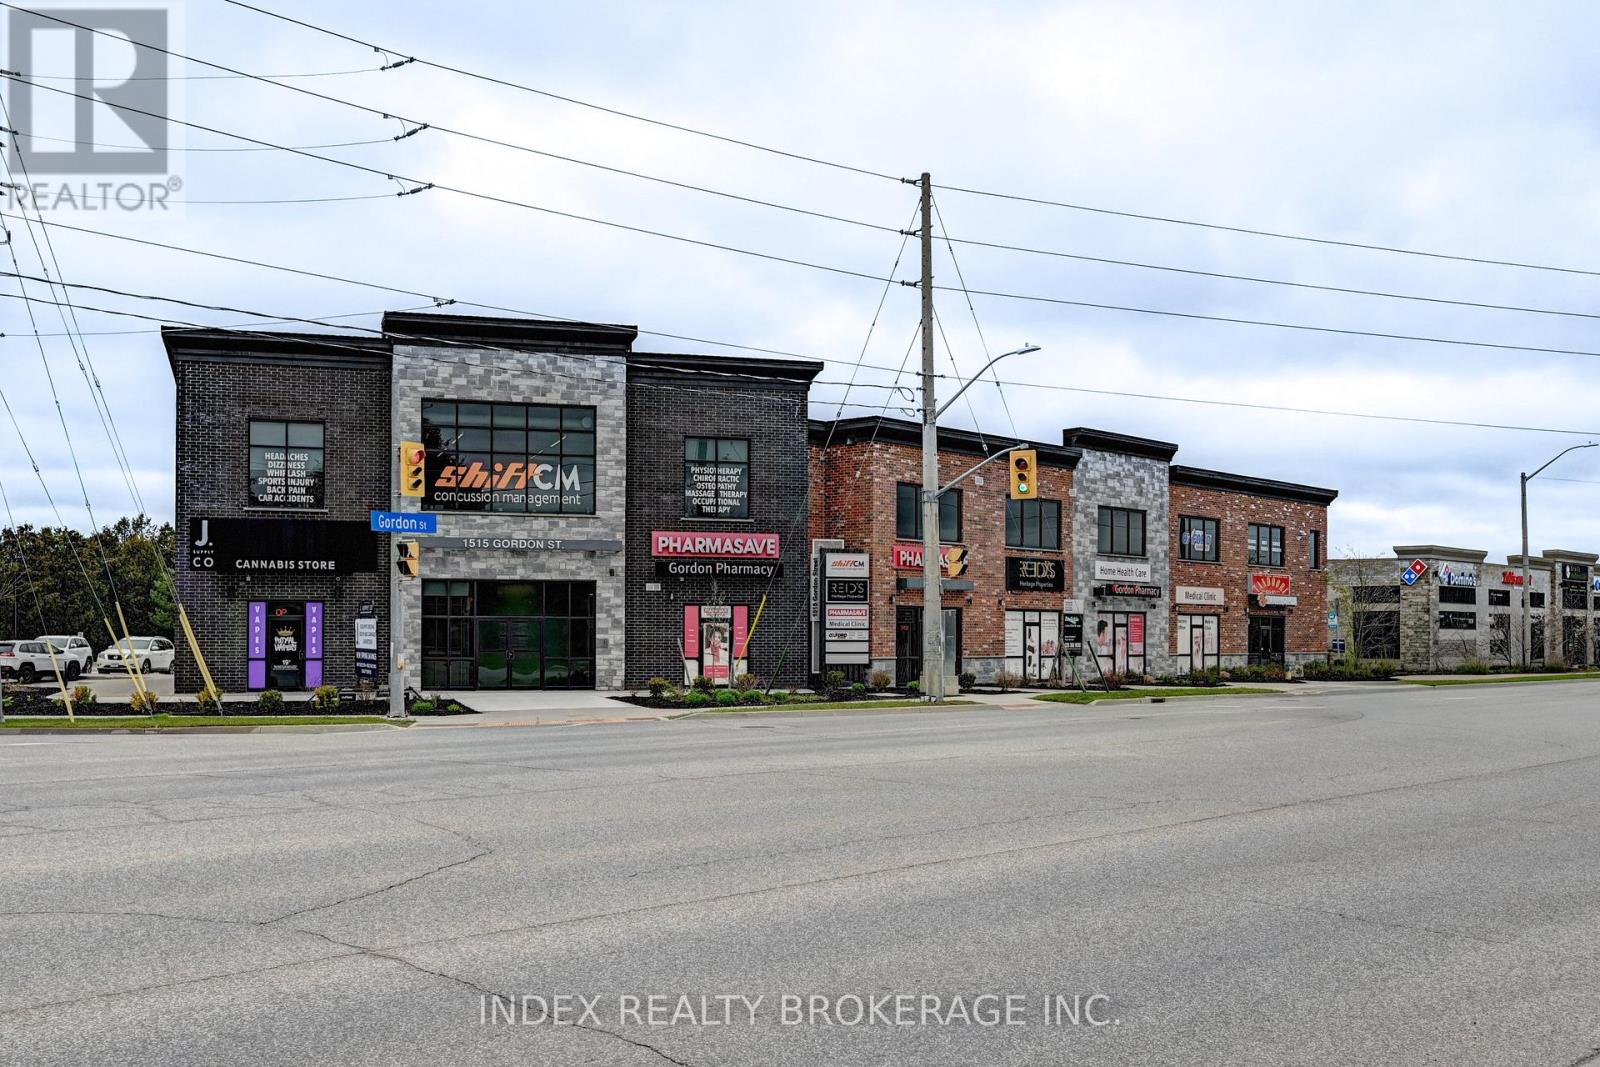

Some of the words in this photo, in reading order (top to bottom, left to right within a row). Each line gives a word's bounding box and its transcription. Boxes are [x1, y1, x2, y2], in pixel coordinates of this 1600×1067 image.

[258, 477, 286, 485] SPORTS
[287, 478, 315, 486] INJURY
[696, 482, 737, 490] OSTEOPATHY
[266, 486, 286, 494] BACK
[288, 486, 306, 494] PAIN
[719, 490, 748, 498] THERAPY
[258, 494, 273, 502] CAR
[434, 490, 500, 502] concussion
[502, 492, 581, 506] management
[378, 514, 417, 529] Gordon
[419, 520, 428, 530] St
[462, 538, 489, 548] 1515
[493, 540, 544, 549] GORDON
[547, 540, 565, 550] ST.
[658, 536, 776, 554] PHARMASAVE
[193, 557, 214, 567] CO
[235, 560, 295, 569] CANNABIS
[298, 560, 336, 570] STORE
[668, 562, 712, 574] Gordon
[716, 562, 774, 577] Pharmacy
[1100, 566, 1116, 576] Home
[1116, 567, 1134, 576] Health
[1135, 568, 1147, 578] Care
[1450, 572, 1476, 586] Domino's
[1113, 584, 1134, 594] Gordon
[1134, 586, 1160, 597] Pharmacy
[1184, 591, 1202, 600] Medical
[1204, 592, 1216, 600] Clinic
